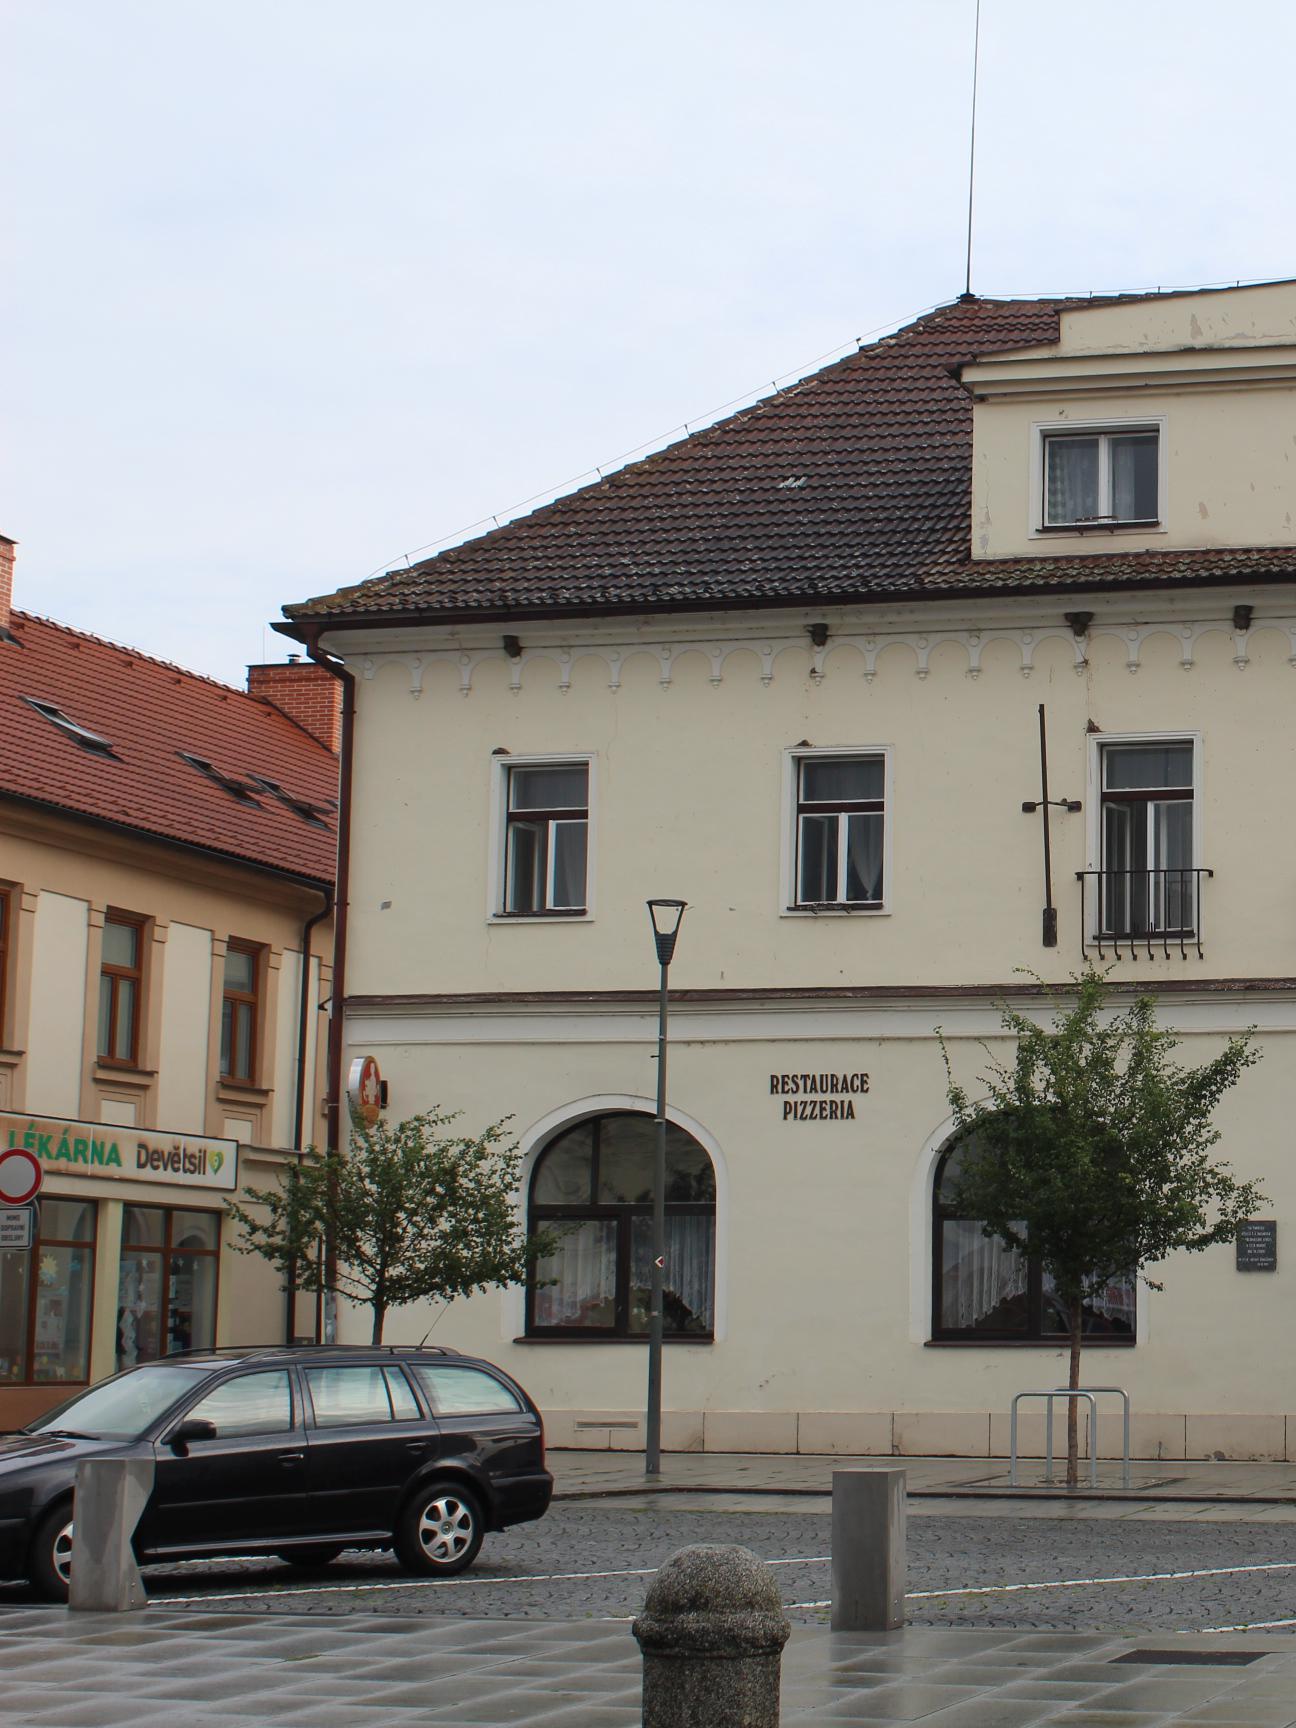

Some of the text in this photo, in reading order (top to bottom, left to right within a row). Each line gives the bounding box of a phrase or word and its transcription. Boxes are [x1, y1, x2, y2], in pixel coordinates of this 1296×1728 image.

[770, 1073, 870, 1095] RESTAURACE
[783, 1100, 856, 1121] PIZZERIA
[136, 1143, 207, 1176] Devětsil
